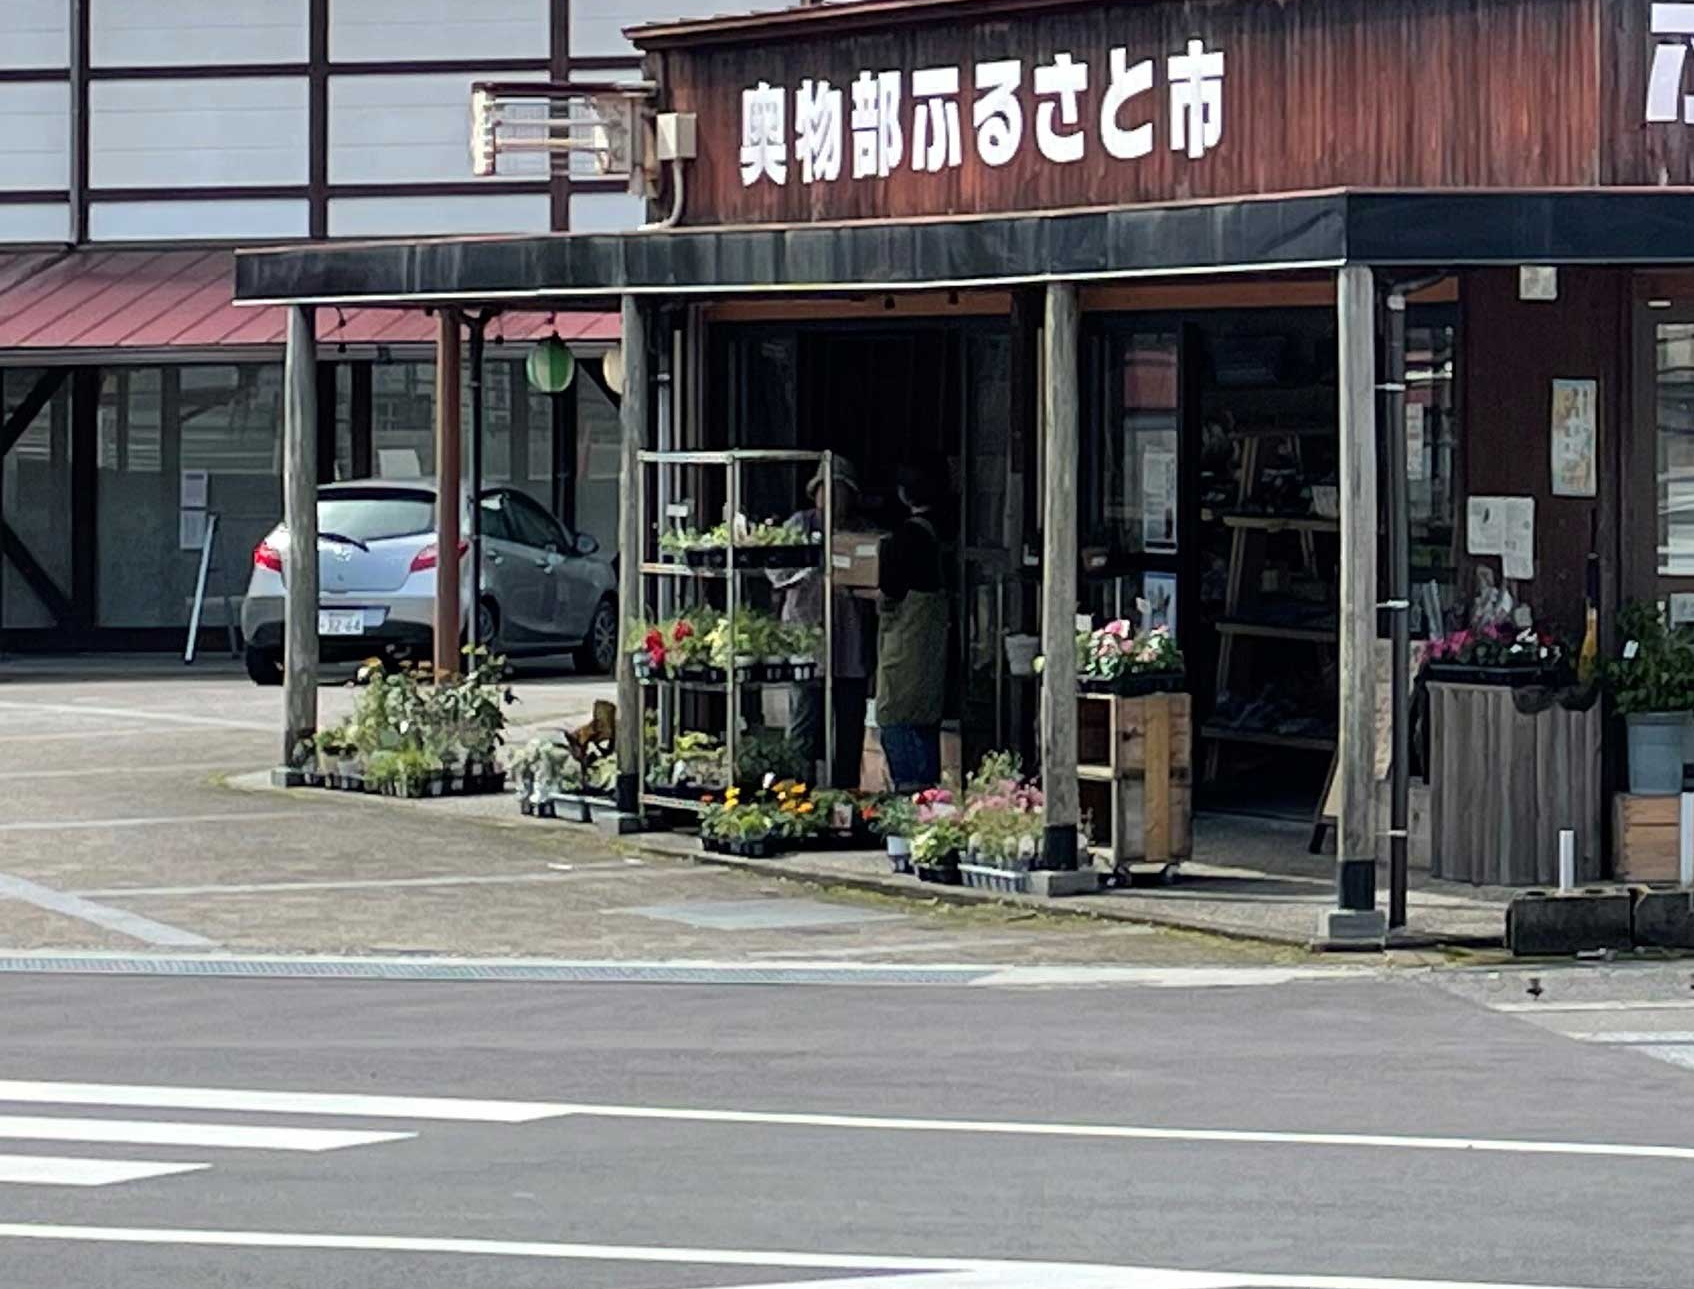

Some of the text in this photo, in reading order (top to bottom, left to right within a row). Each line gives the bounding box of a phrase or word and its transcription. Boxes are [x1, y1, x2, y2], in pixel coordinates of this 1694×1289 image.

[739, 39, 1224, 186] 奥物部ふるさと市
